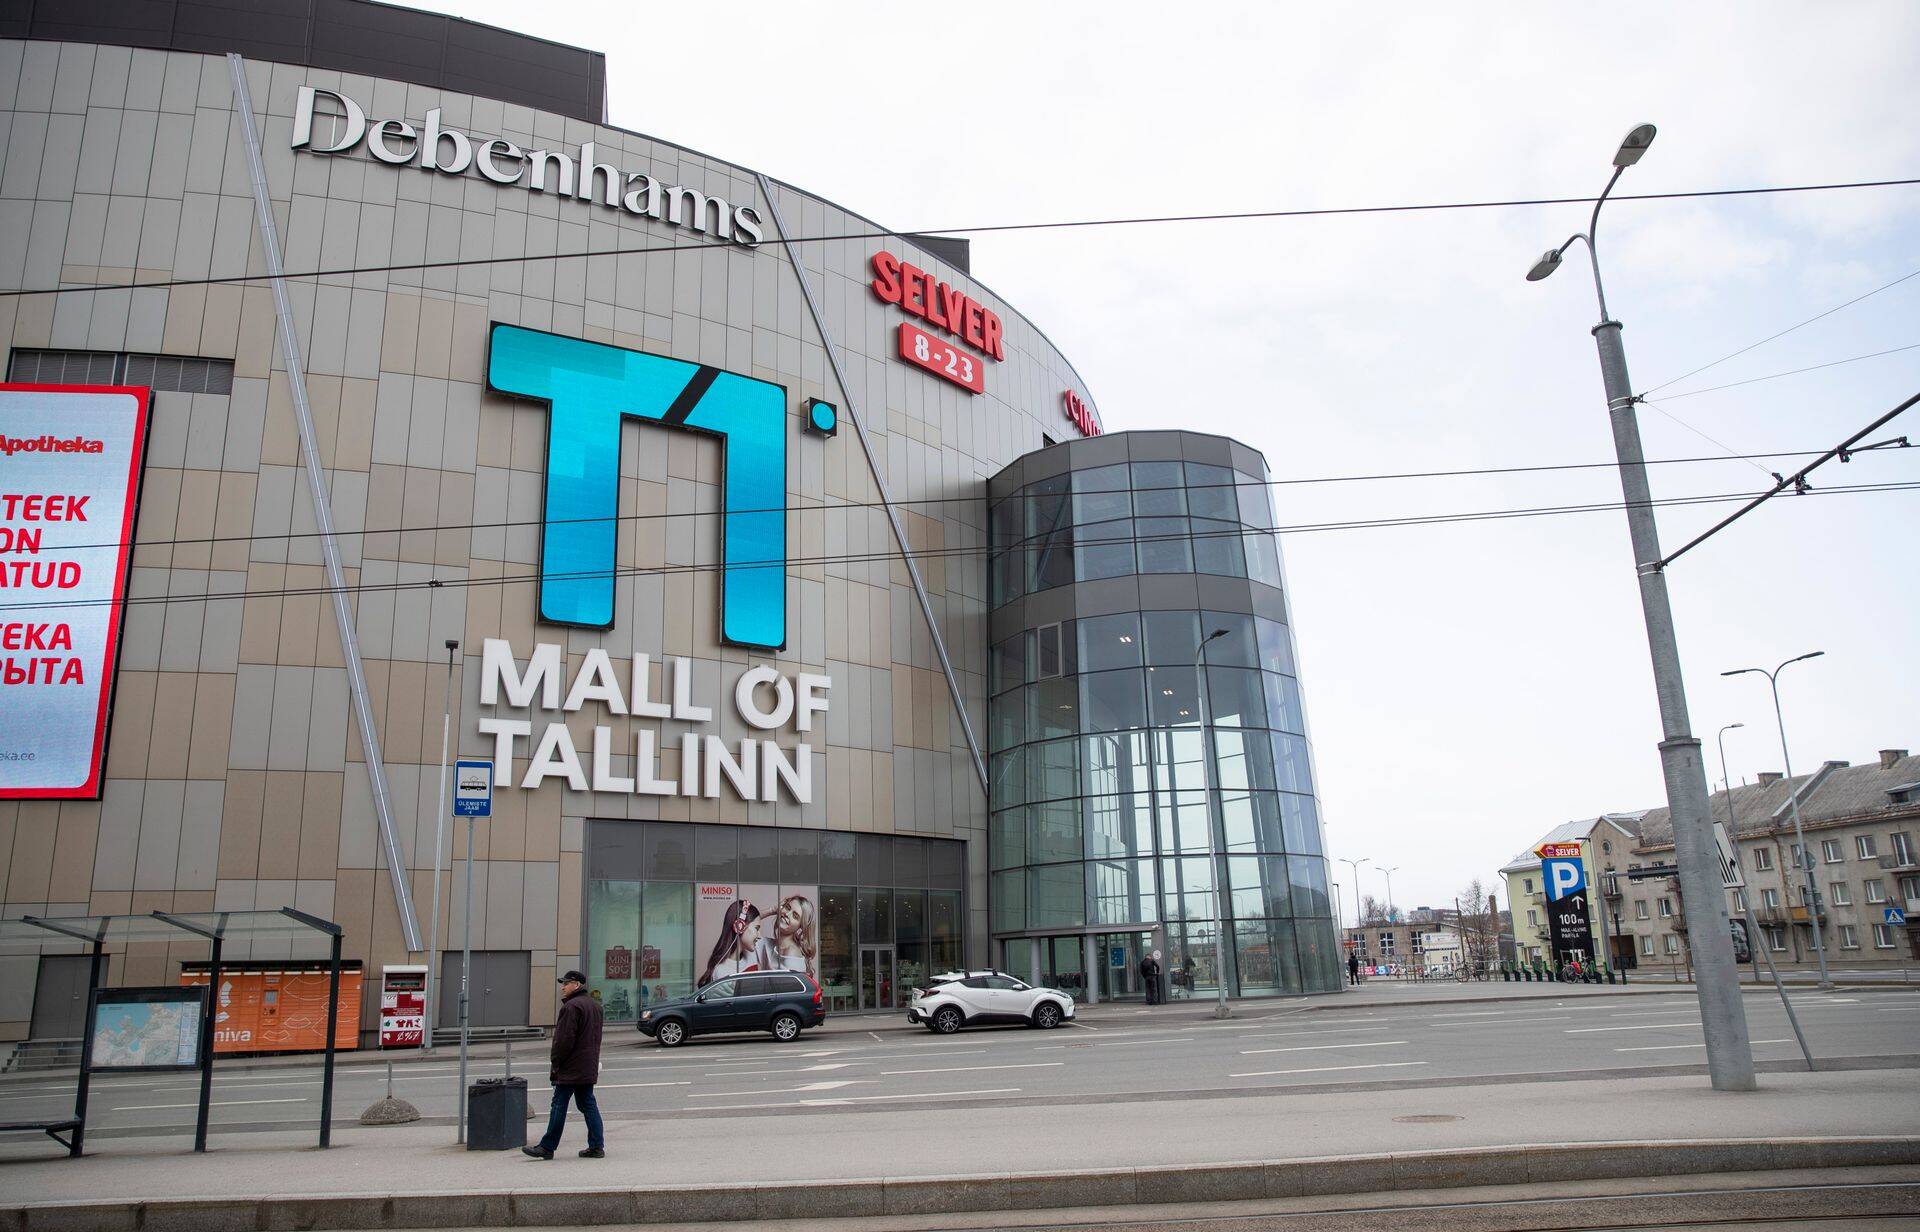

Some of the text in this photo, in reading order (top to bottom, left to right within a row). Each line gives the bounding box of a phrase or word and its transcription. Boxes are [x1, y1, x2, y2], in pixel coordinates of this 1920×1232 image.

[291, 85, 764, 247] Debenhams
[871, 250, 1005, 362] SELVER
[1064, 389, 1101, 438] CIN
[484, 320, 788, 652] T1
[2, 494, 91, 522] TEEK
[0, 622, 72, 650] ЕКА
[0, 657, 84, 685] ЫТА
[480, 638, 832, 732] MALL OF
[478, 718, 812, 804] TALLINN
[1555, 848, 1580, 857] SELVER
[701, 886, 733, 895] MINISO
[1551, 862, 1579, 901] P
[609, 955, 630, 964] MINI
[214, 1027, 251, 1042] niva
